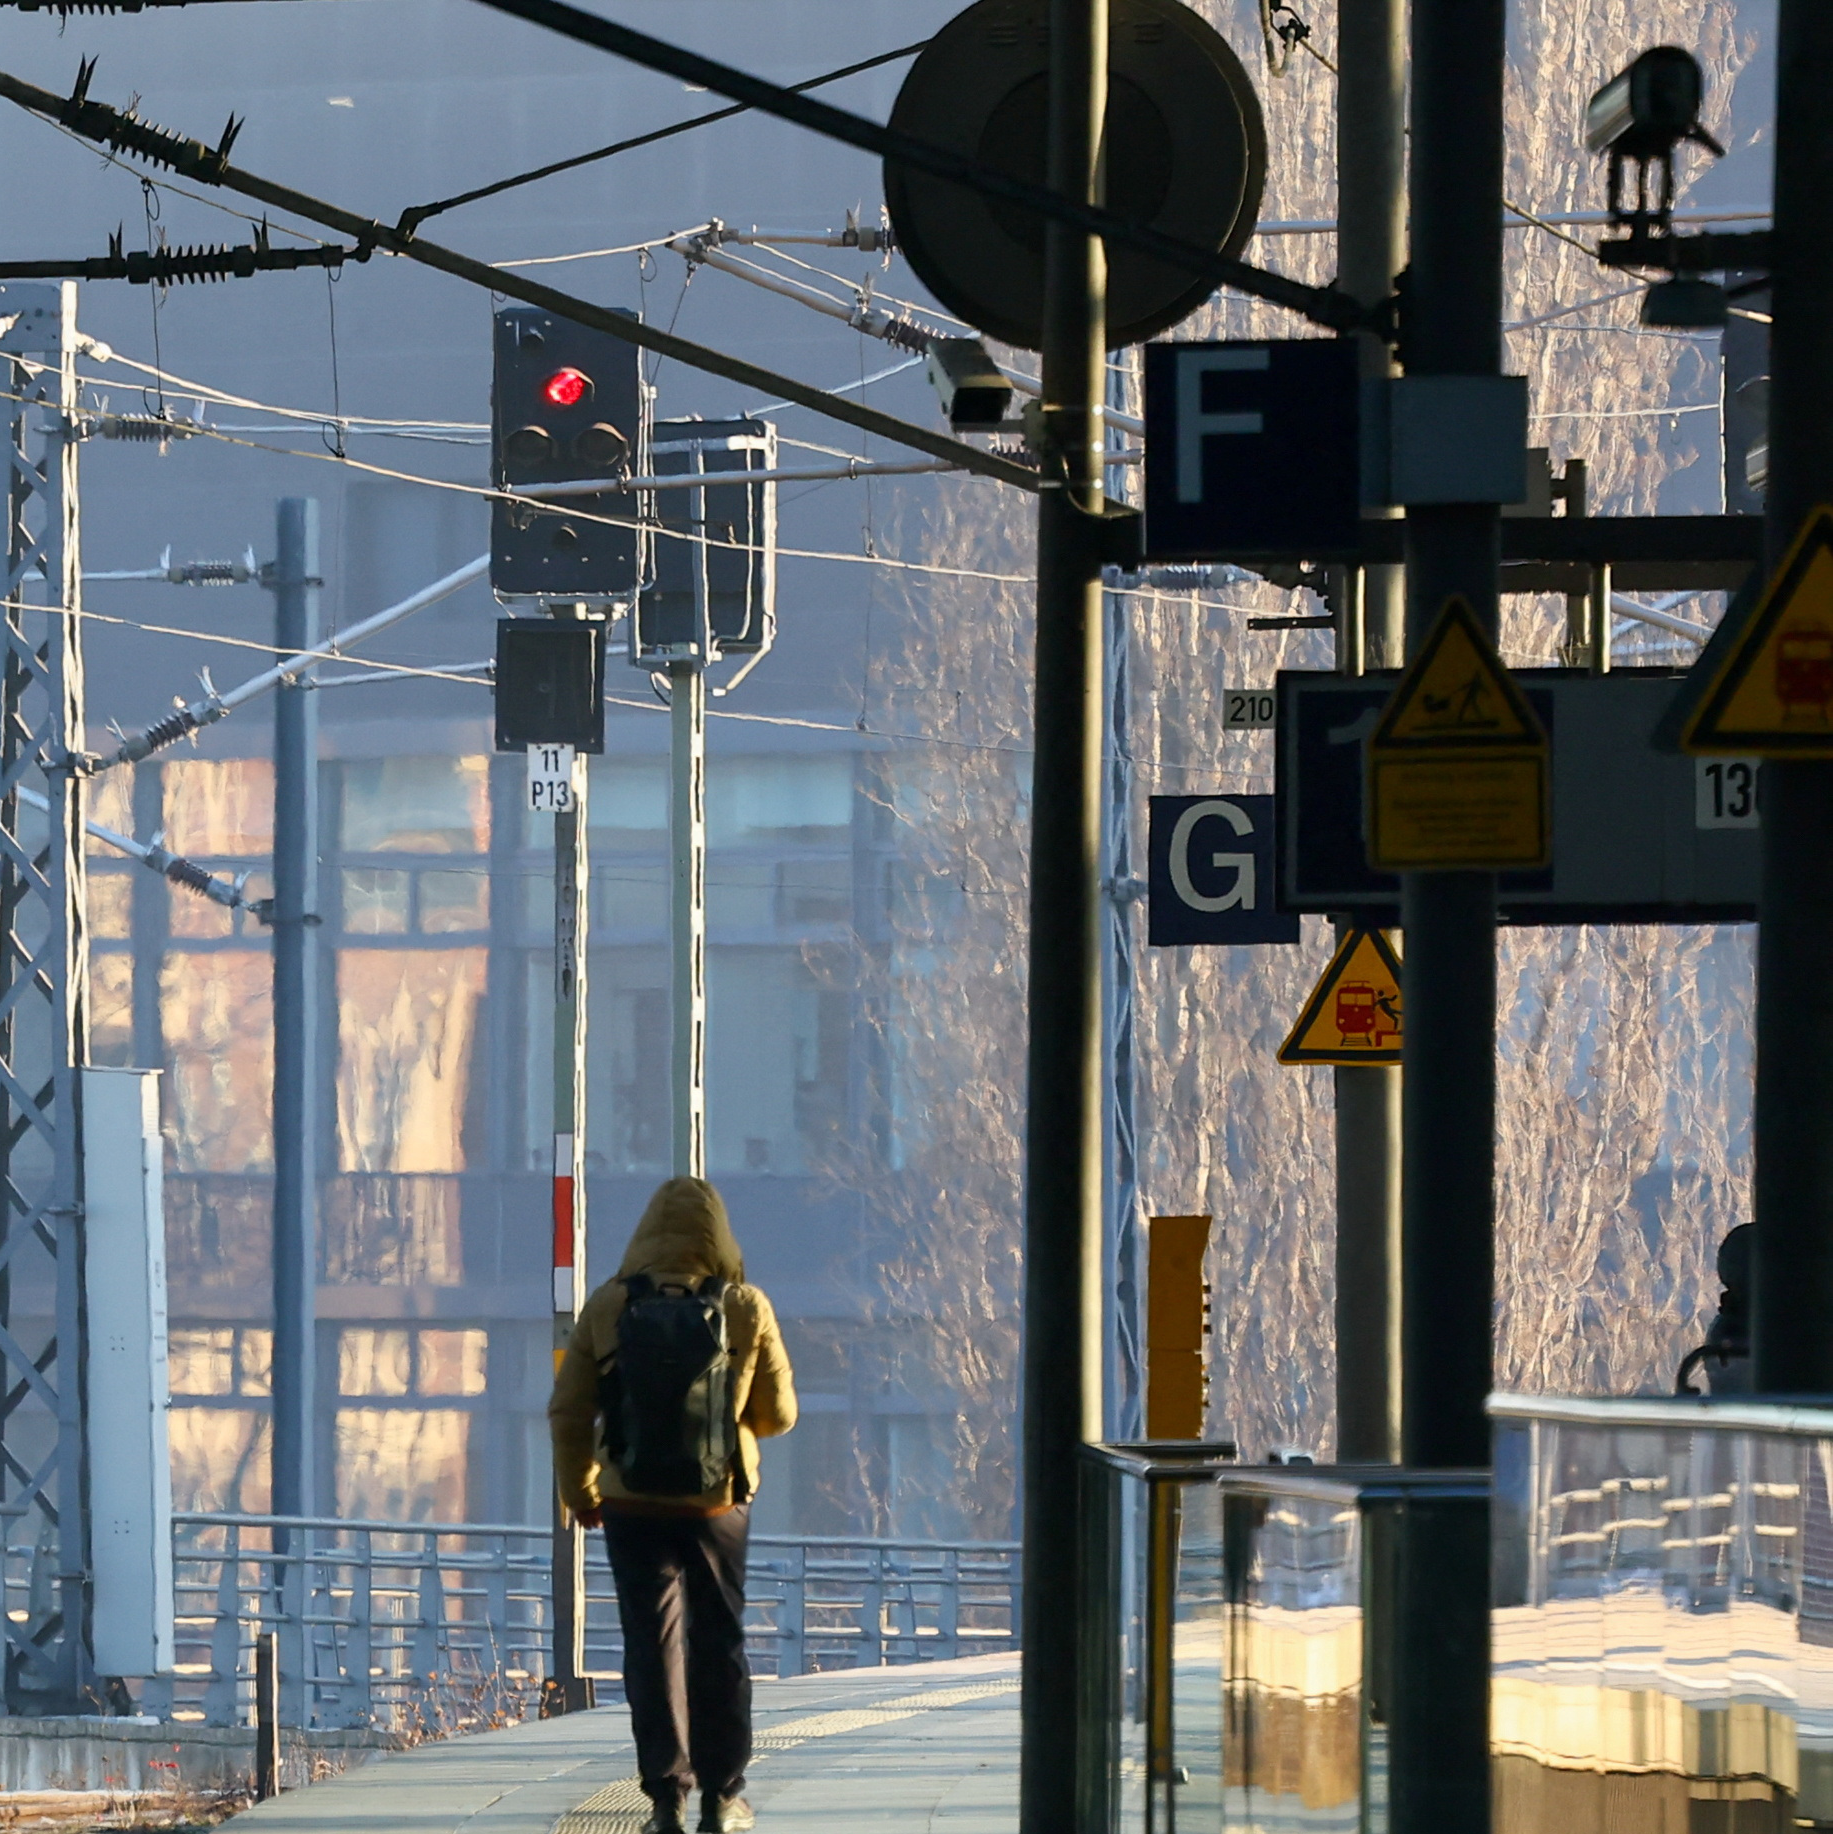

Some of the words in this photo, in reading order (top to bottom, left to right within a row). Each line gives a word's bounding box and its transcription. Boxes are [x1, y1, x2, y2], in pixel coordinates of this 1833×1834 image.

[1177, 348, 1271, 504] F
[1230, 696, 1273, 722] 210
[542, 749, 559, 772] 11
[532, 780, 569, 807] P13
[1705, 762, 1761, 818] 13
[1169, 799, 1256, 913] G
